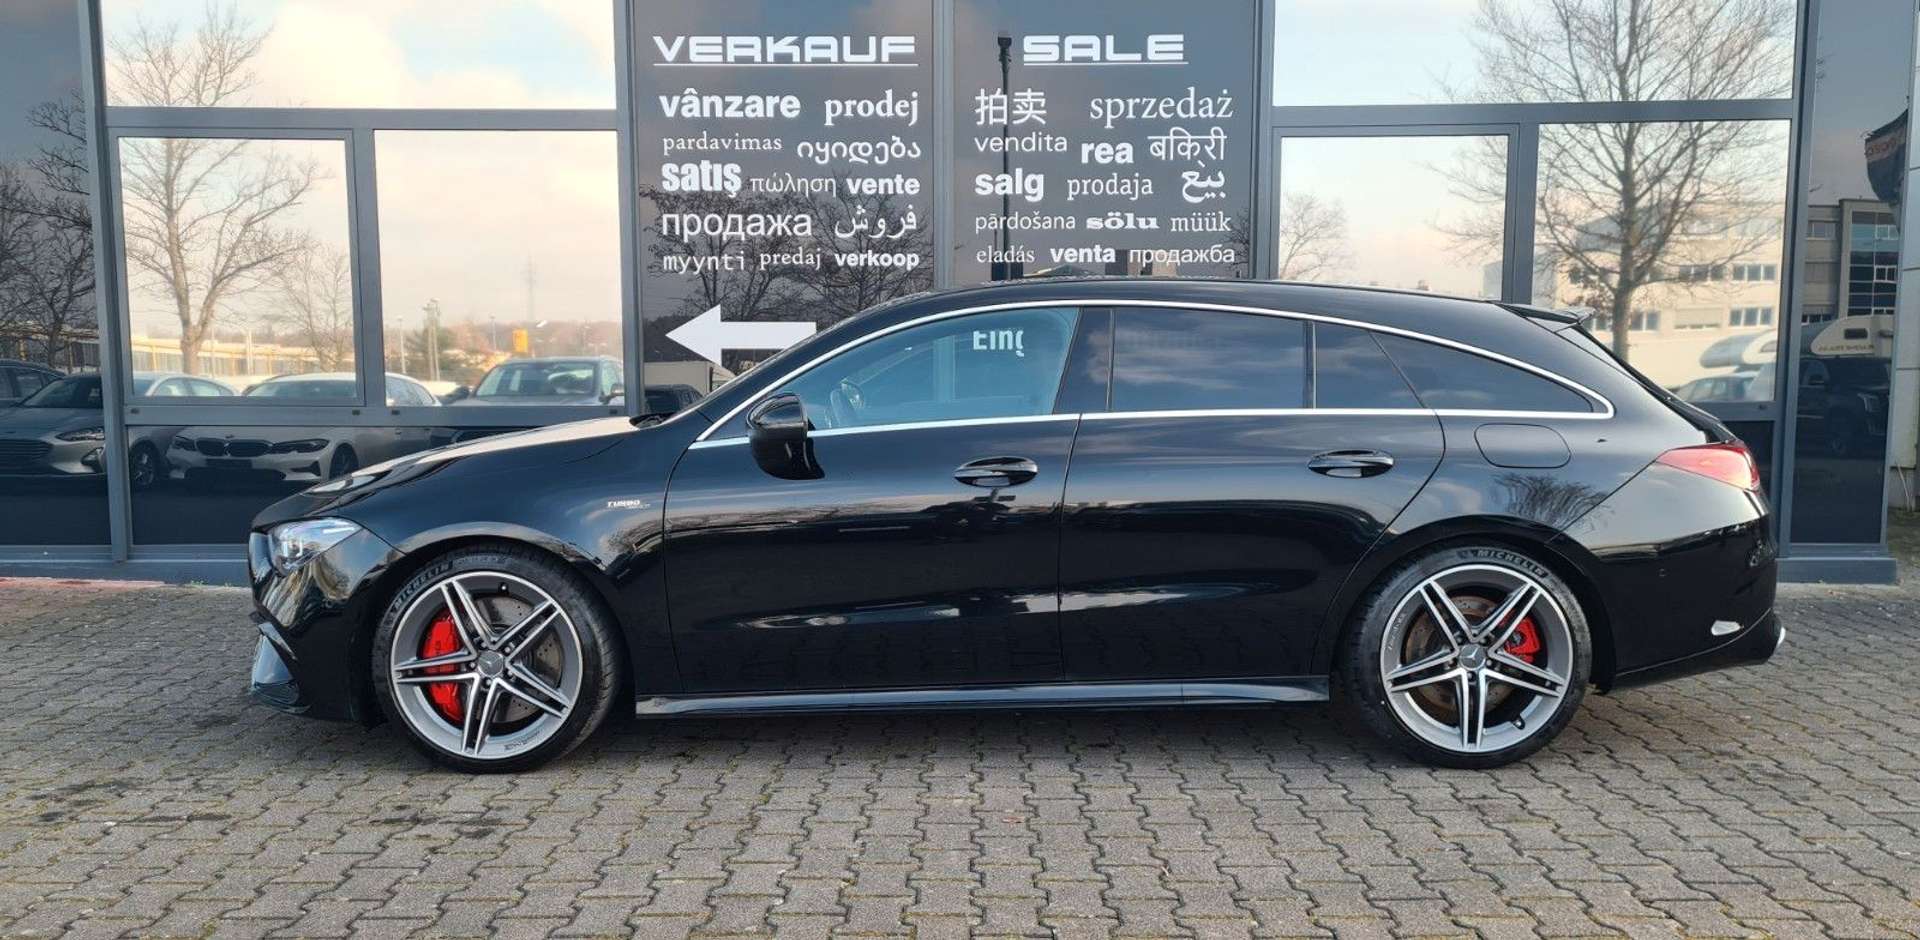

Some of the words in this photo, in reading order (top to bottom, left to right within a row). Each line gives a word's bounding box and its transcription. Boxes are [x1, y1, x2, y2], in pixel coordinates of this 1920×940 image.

[652, 35, 915, 62] VERKAUF
[1023, 34, 1184, 62] SALE
[658, 87, 801, 119] vânzare
[824, 88, 918, 127] prodej
[974, 87, 1047, 126] 拍卖
[1090, 86, 1234, 129] sprzedaż
[662, 130, 783, 156] pardavimas
[797, 135, 922, 165] იყიდება
[974, 131, 1068, 153] vendita
[1081, 142, 1134, 164] rea
[661, 159, 742, 199] satış
[749, 172, 837, 198] πώληση
[846, 174, 921, 195] vente
[974, 167, 1044, 203] salg
[1066, 172, 1154, 201] prodaja
[1181, 170, 1226, 204] بيع
[662, 213, 812, 243] продажа
[975, 210, 1076, 234] pārdošana
[1086, 211, 1160, 230] sölu
[1170, 210, 1231, 232] müük
[663, 250, 745, 275] myynti
[759, 246, 821, 271] predaj
[833, 249, 920, 272] verkoop
[976, 245, 1035, 263] eladás
[1049, 244, 1116, 263] venta
[1129, 244, 1235, 267] продажба
[1477, 549, 1546, 577] MICHELIN
